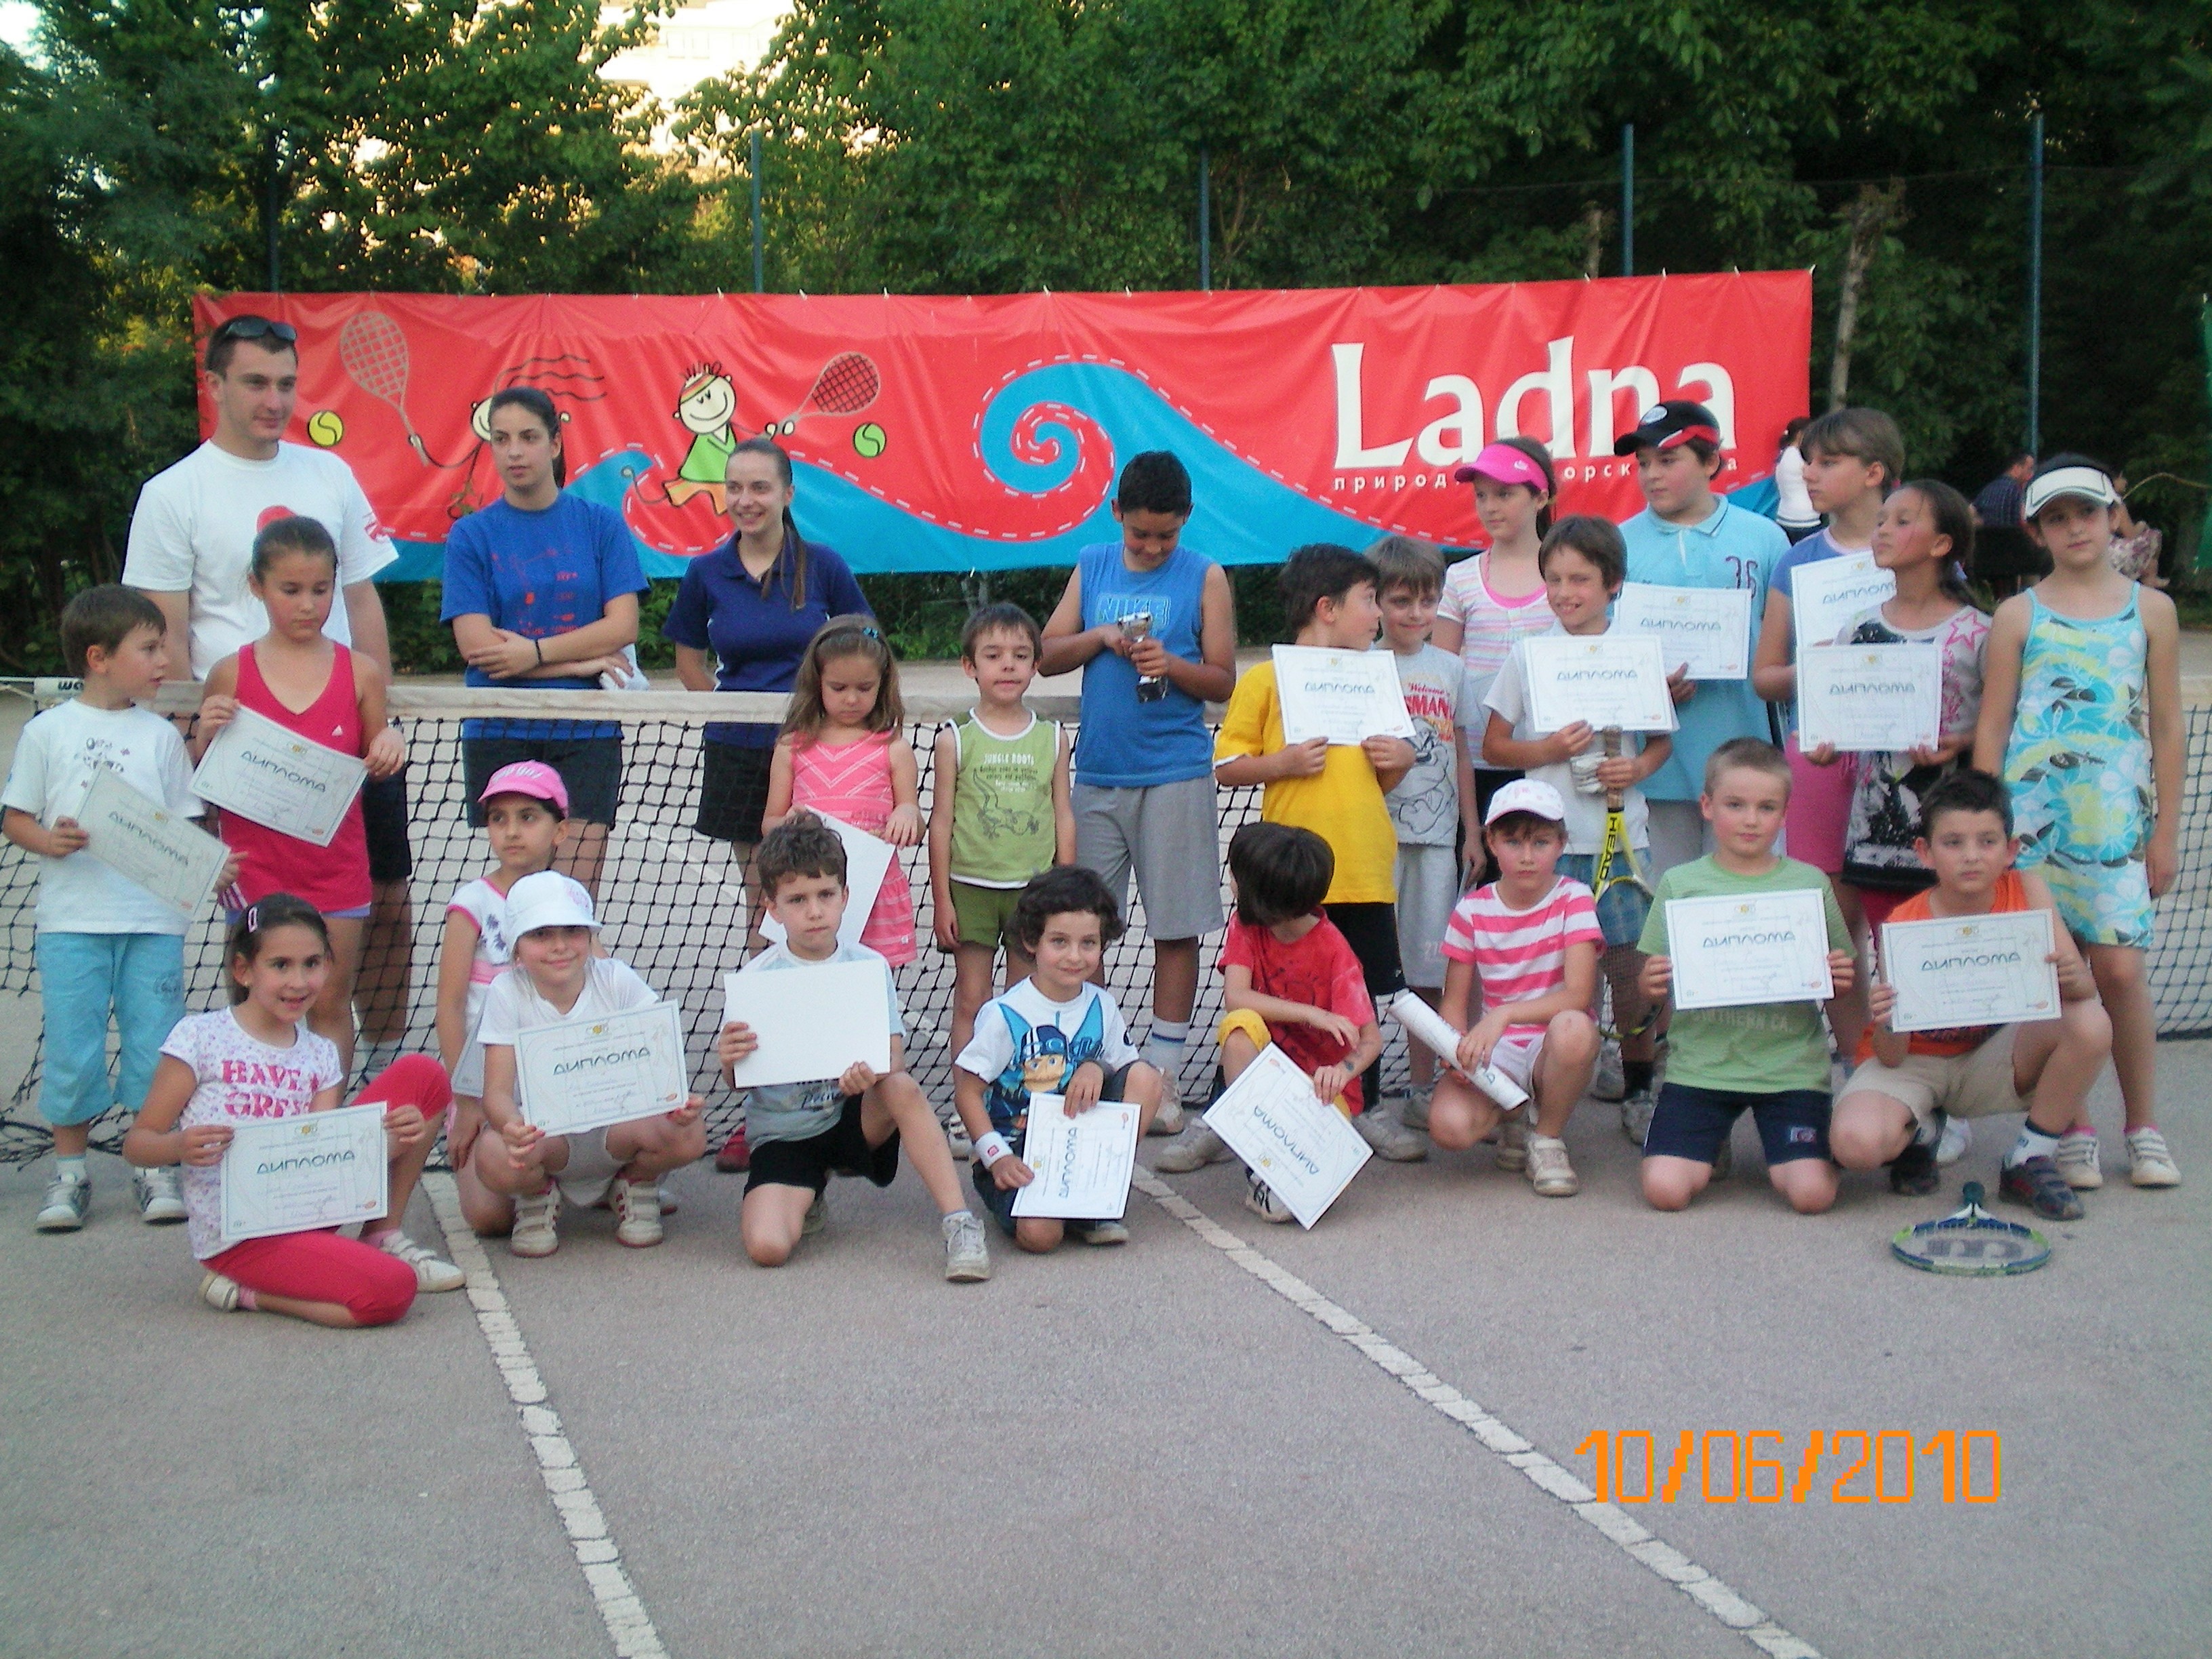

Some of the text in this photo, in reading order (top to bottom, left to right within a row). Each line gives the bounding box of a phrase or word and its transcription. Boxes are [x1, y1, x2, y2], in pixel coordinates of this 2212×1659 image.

[1332, 335, 1737, 468] Ladna
[1334, 474, 1459, 494] природ
[1823, 582, 1893, 604] ДИПЛОМ
[1641, 617, 1721, 631] ДИПЛОМА
[1557, 669, 1638, 681] ДИПЛОМА
[1305, 682, 1375, 693] ДИПЛОМА
[1830, 682, 1915, 695] ДИПЛОМА
[241, 750, 326, 792] ДИПЛОМА
[108, 811, 188, 866] ДИПЛОМА
[1599, 817, 1618, 880] HEAD
[1703, 930, 1796, 947] ДИПЛОМА
[1922, 952, 2022, 971] ДИПЛОМА
[553, 1047, 651, 1076] ДИПЛОМА
[222, 1060, 301, 1092] HAVE
[1254, 1105, 1319, 1174] ДИПЛОМА
[257, 1150, 355, 1174] ДИПЛОМА
[1059, 1127, 1078, 1200] ДИПЛОМА
